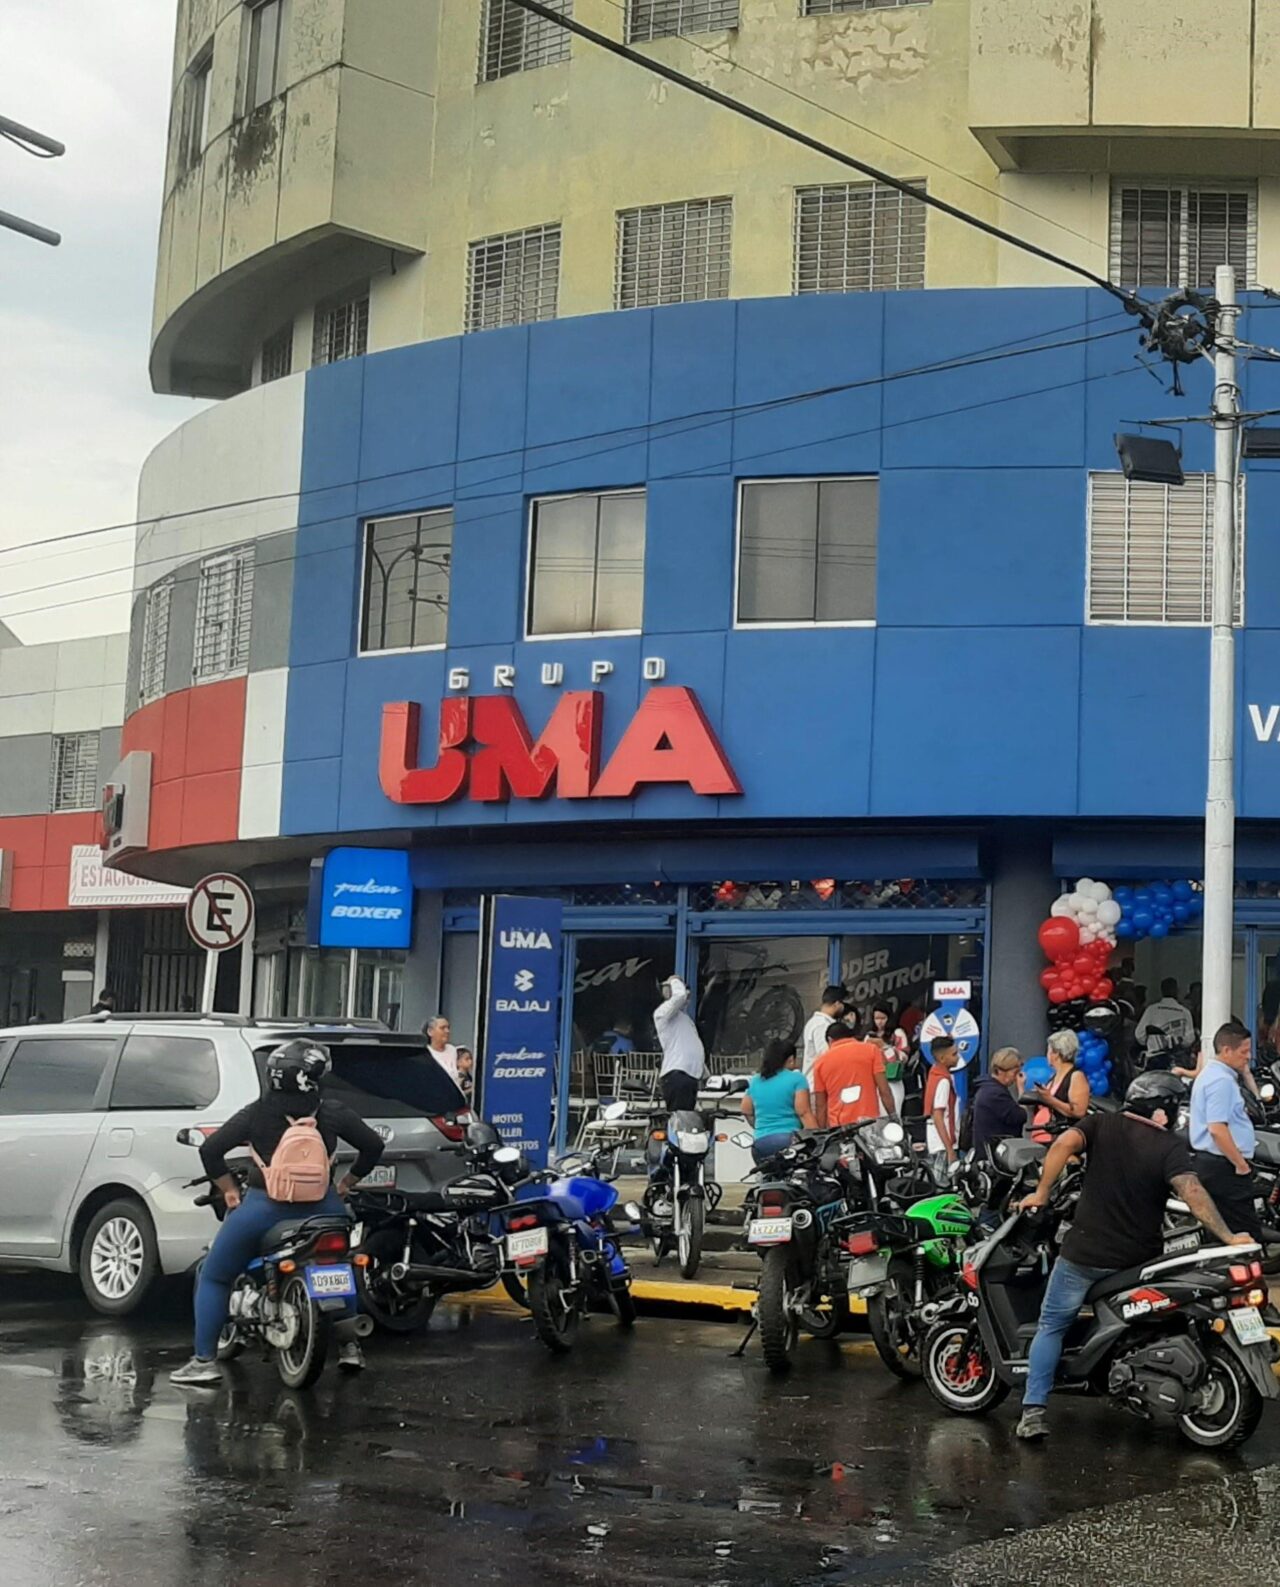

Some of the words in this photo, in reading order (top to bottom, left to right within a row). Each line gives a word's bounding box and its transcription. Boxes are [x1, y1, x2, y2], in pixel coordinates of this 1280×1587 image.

[448, 657, 666, 690] GRUPO
[378, 686, 744, 804] UMA
[206, 891, 235, 931] E
[330, 905, 403, 919] BOXER
[500, 930, 552, 949] UMA
[938, 987, 966, 996] UMA
[495, 1000, 550, 1012] BAJAJ
[493, 1067, 545, 1078] BOXER
[492, 1113, 523, 1124] MOTOS
[497, 1127, 522, 1137] LLER
